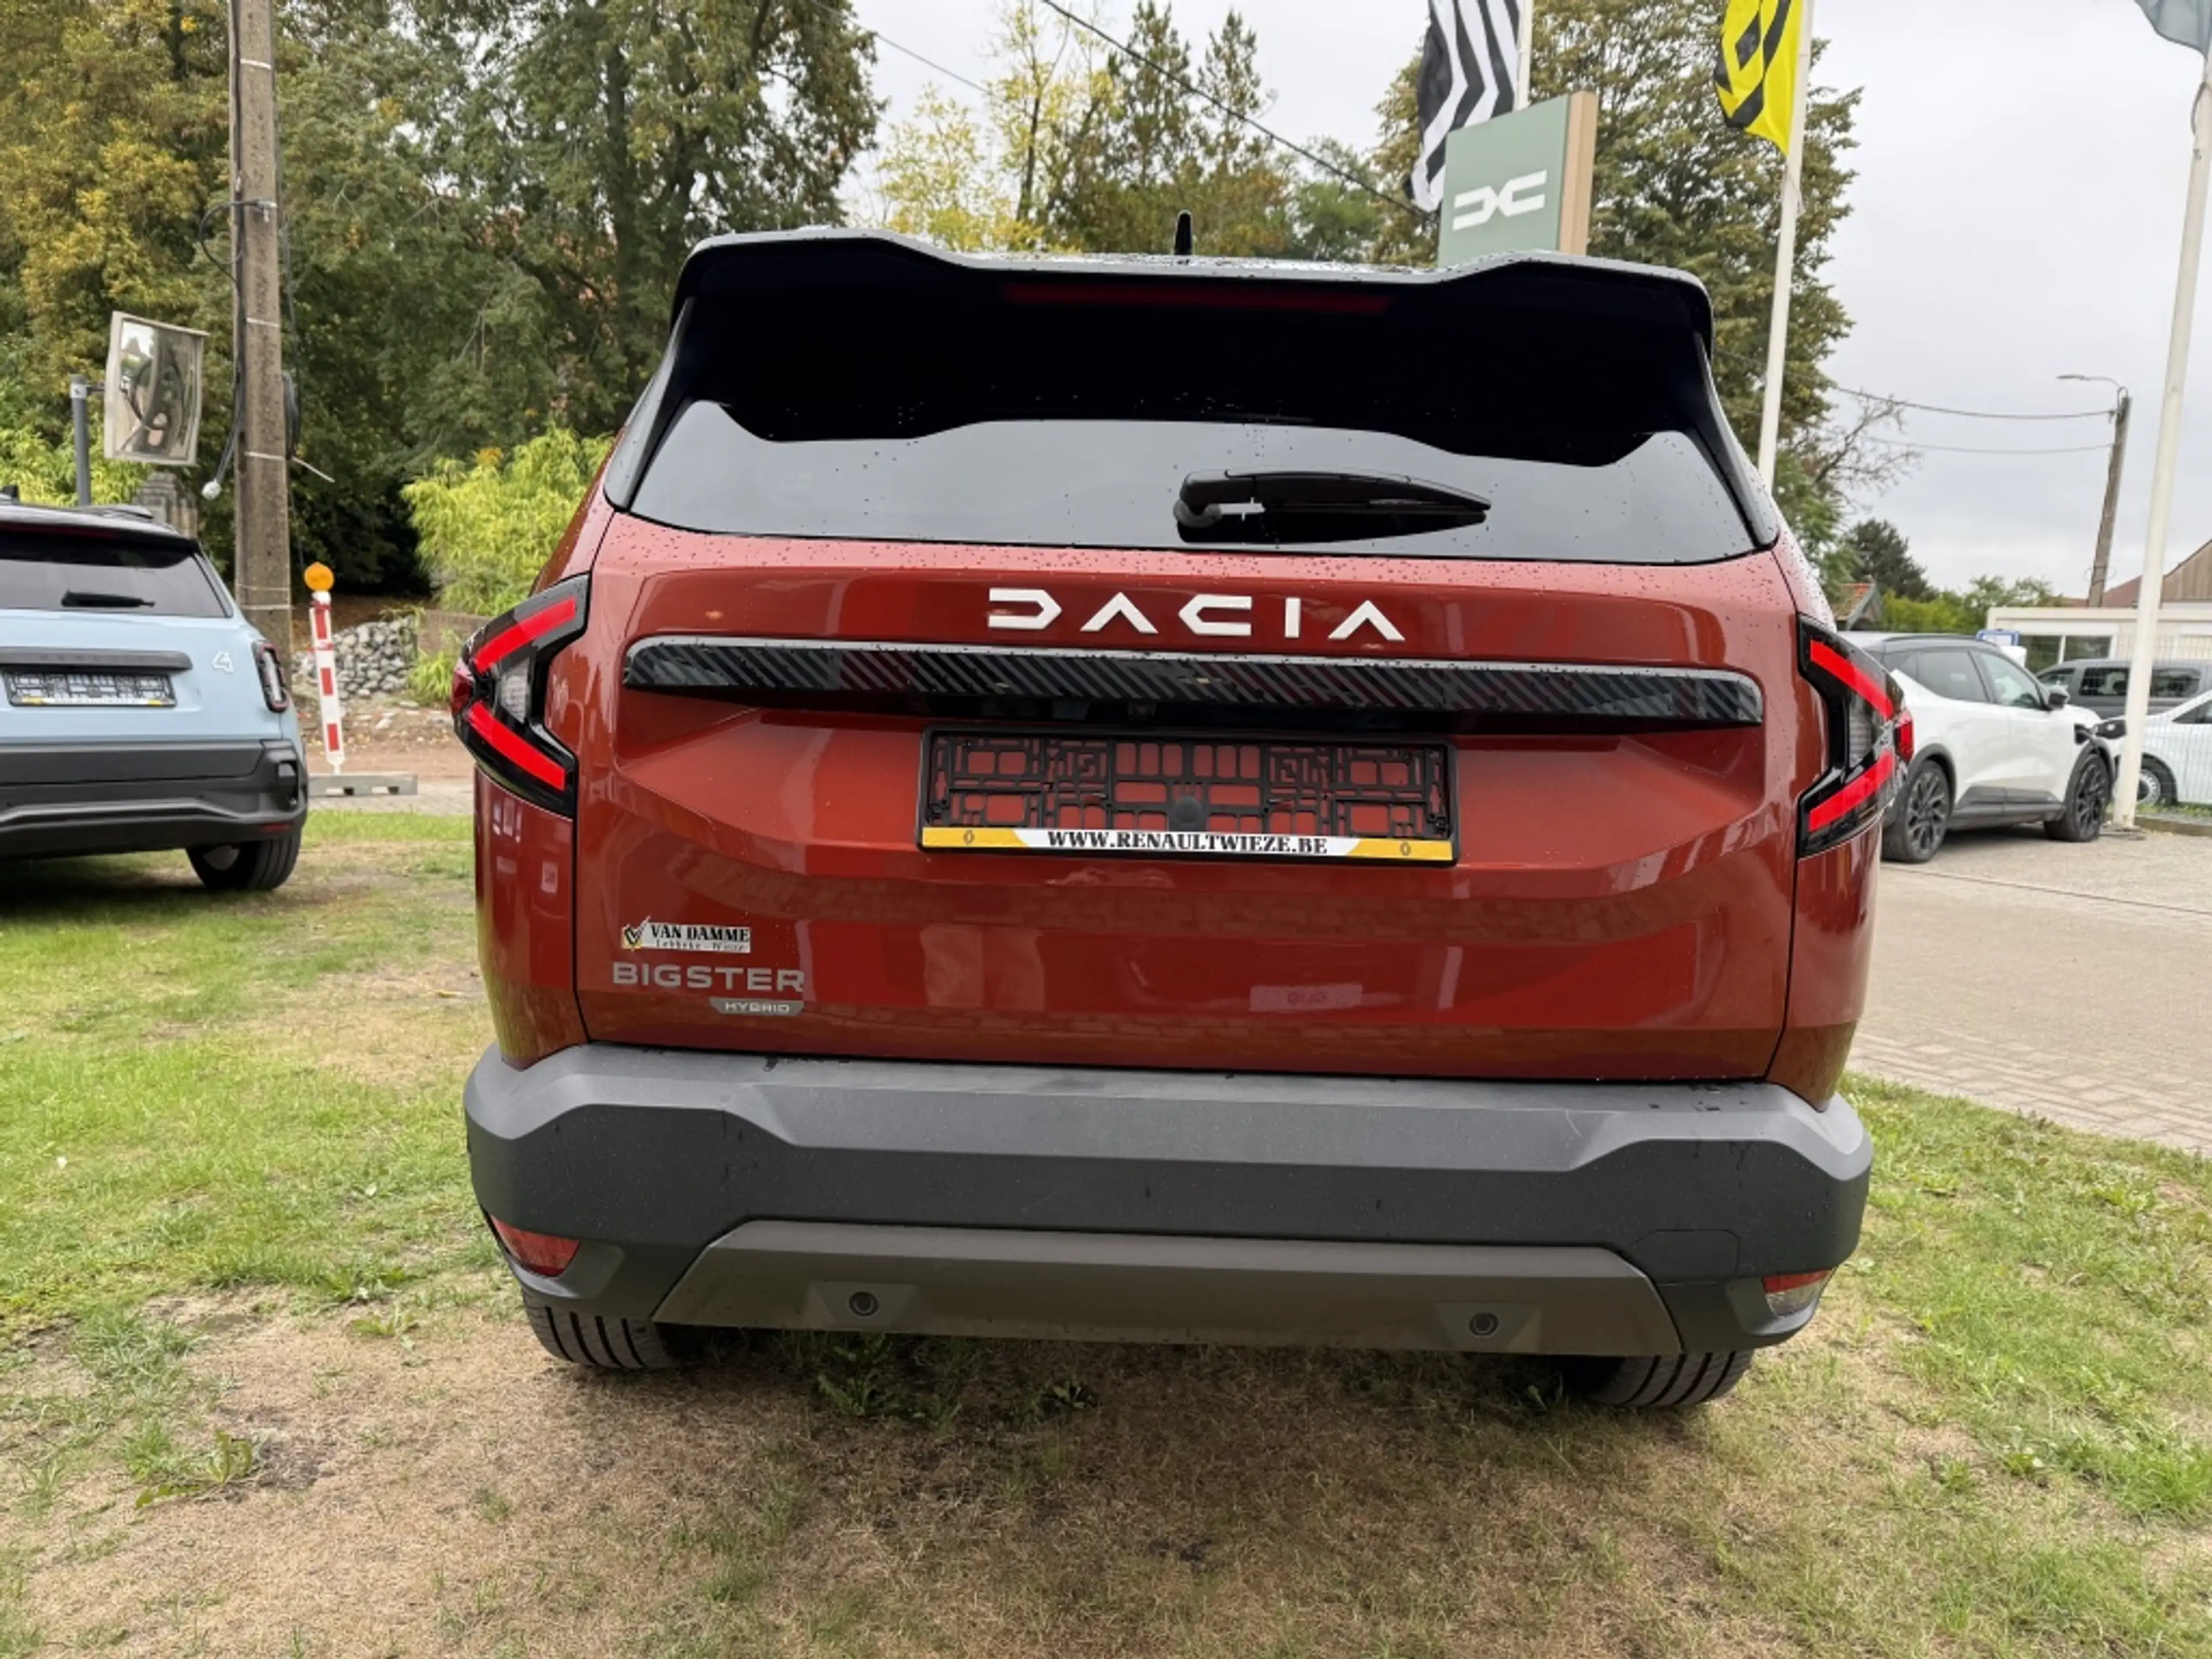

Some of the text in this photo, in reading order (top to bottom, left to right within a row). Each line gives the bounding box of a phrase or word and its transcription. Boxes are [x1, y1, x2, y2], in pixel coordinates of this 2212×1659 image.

[988, 588, 1406, 641] DACIA
[1048, 830, 1328, 854] WWW.RENAULTWIEZE.BE
[651, 925, 749, 941] VAN DAMME
[613, 961, 805, 992] BIGSTER
[725, 1001, 790, 1013] HYBRID
